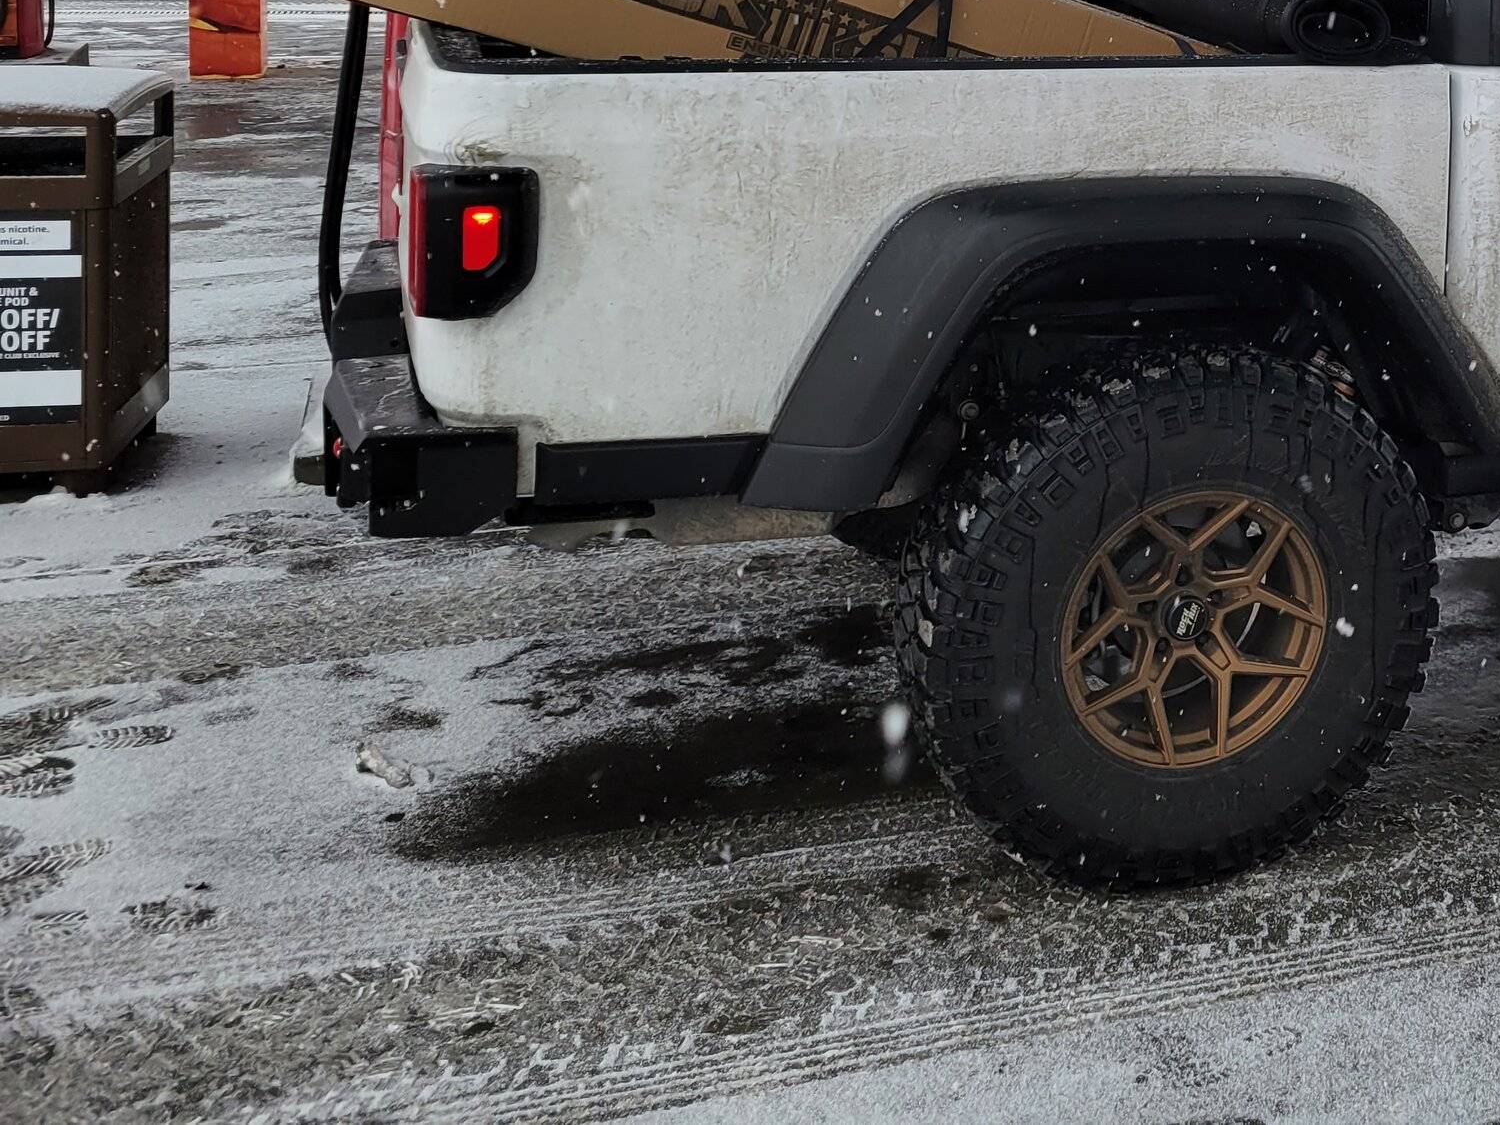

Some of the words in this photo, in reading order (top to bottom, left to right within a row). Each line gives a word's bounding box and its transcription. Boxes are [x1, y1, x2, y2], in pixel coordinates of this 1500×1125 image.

[8, 225, 50, 234] nicotine.
[29, 287, 39, 297] &
[5, 297, 30, 307] POD
[1, 308, 60, 330] OFF/
[1, 330, 51, 352] OFF
